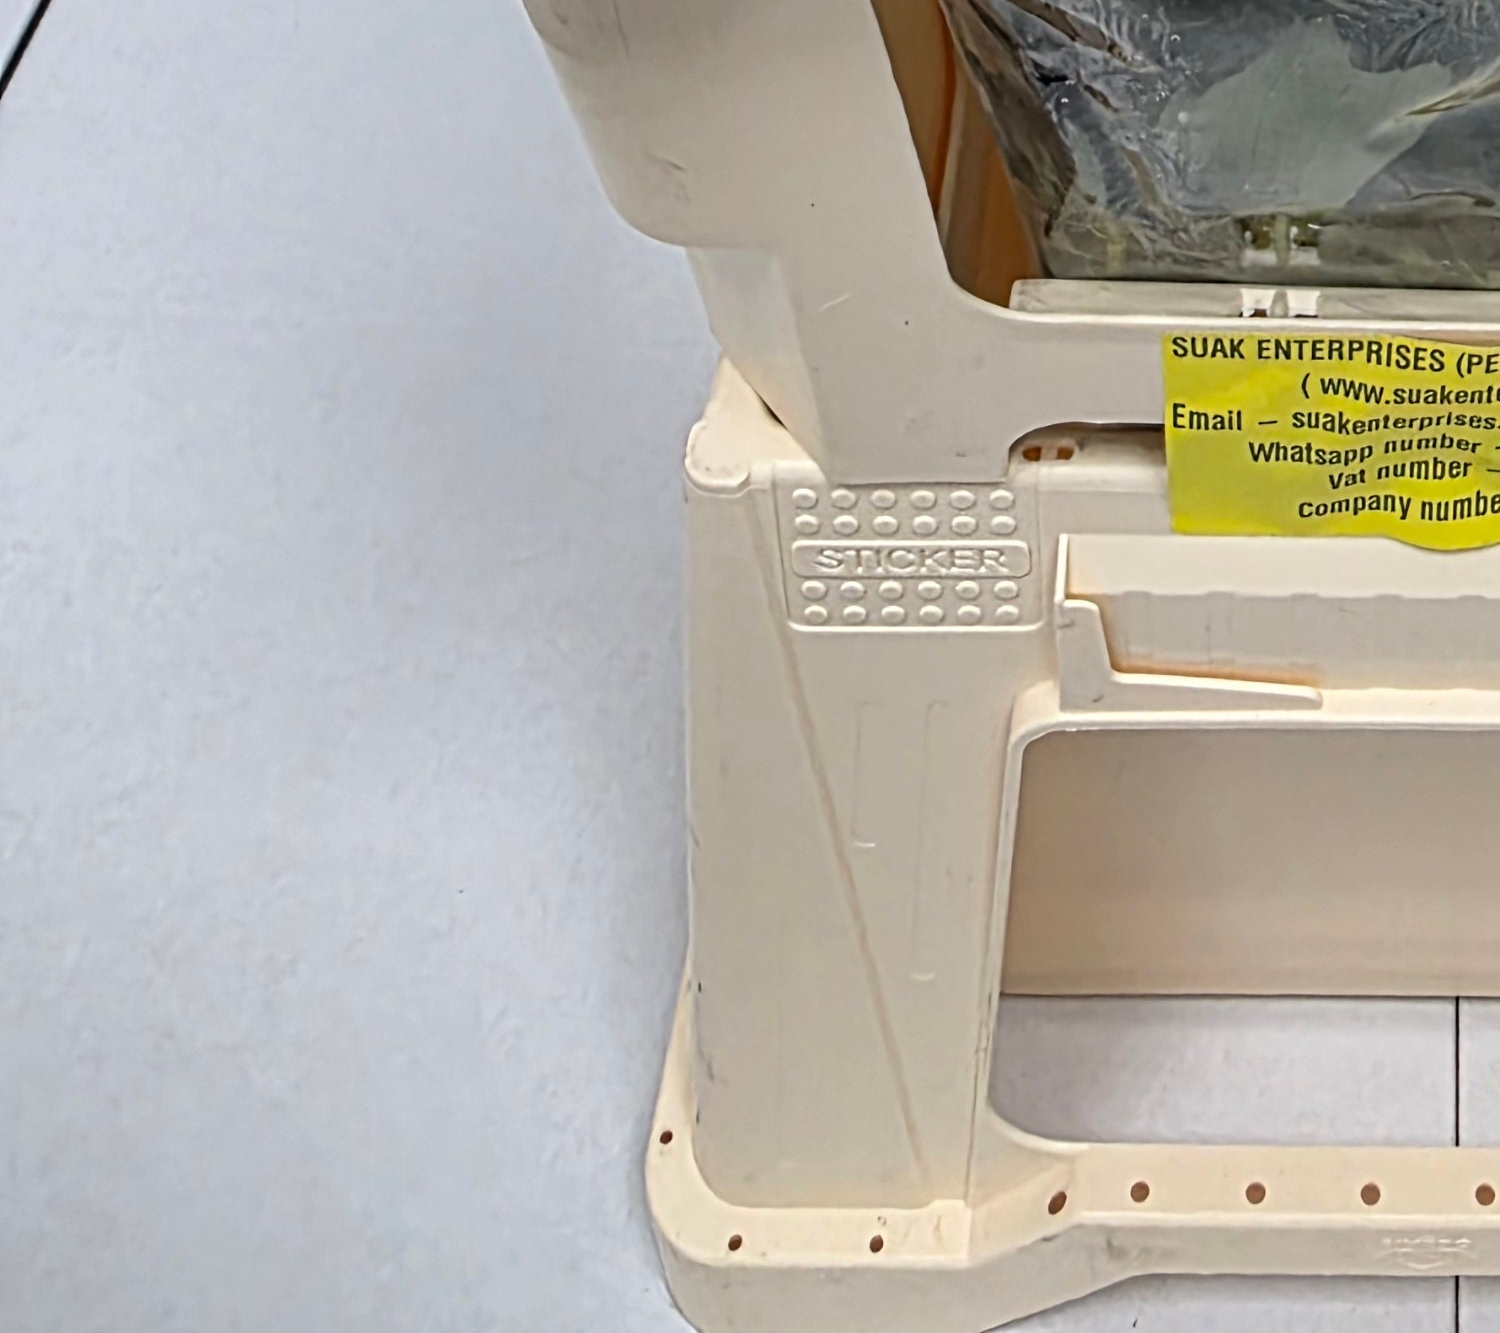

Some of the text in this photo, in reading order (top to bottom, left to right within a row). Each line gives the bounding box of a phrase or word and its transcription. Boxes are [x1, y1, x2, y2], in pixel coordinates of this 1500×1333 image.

[1171, 335, 1246, 360] SUAK
[1257, 337, 1446, 373] ENTERPRISES
[1172, 402, 1243, 432] Email
[1247, 440, 1374, 468] Whatsapp
[1383, 432, 1483, 455] number
[1376, 455, 1474, 481] number
[814, 549, 1008, 574] STICKER
